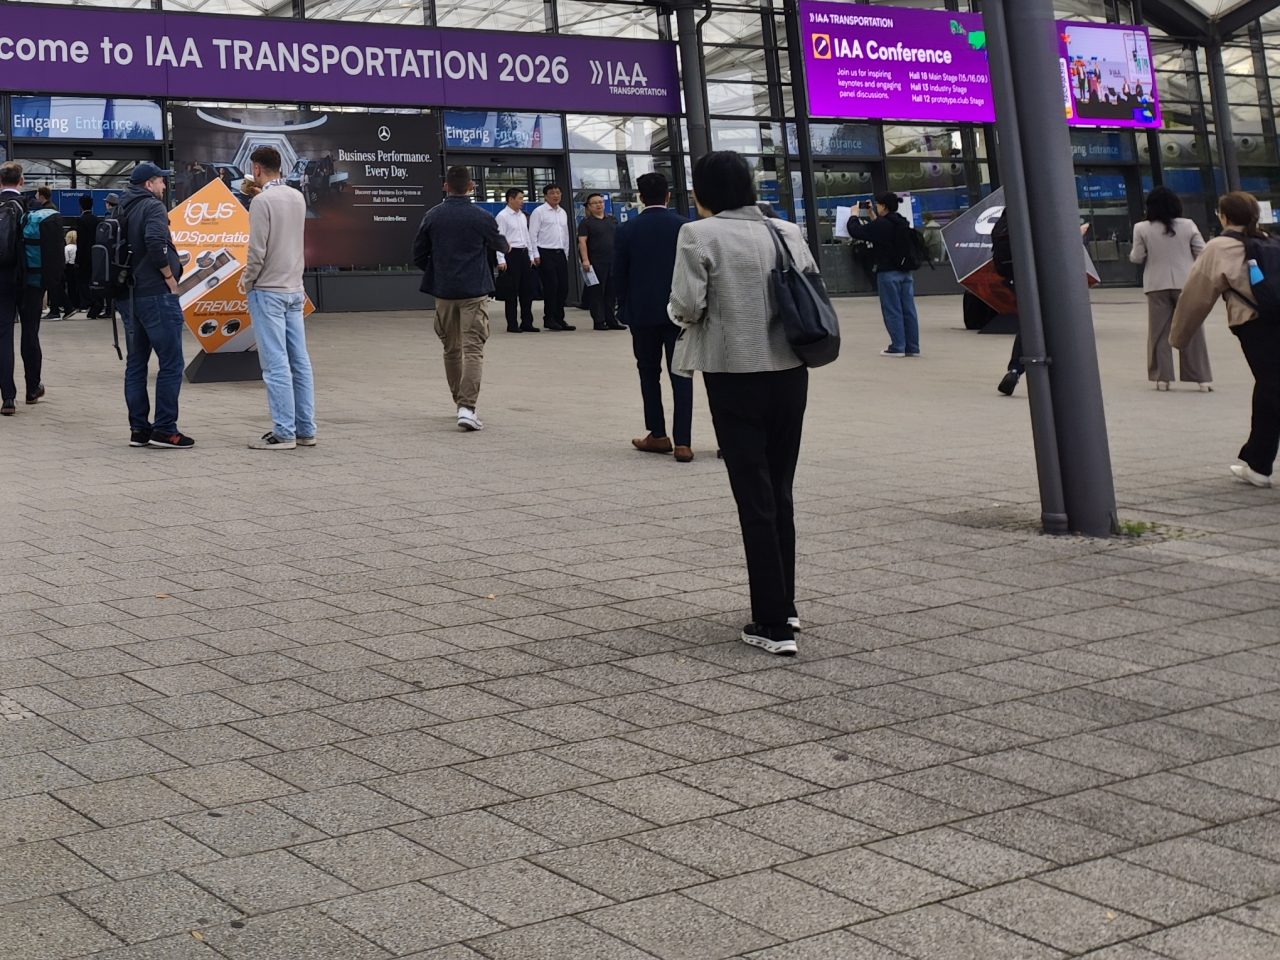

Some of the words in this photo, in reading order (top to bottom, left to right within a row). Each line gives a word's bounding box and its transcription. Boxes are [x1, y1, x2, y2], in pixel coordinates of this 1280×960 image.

[815, 13, 829, 24] IAA
[830, 14, 894, 29] TRANSPORTATION
[833, 37, 864, 59] IAA
[865, 40, 953, 65] Conference
[100, 36, 134, 66] to
[145, 35, 204, 69] IAA
[212, 38, 489, 81] TRANSPORTATION
[497, 53, 570, 85] 2026
[606, 61, 648, 87] IAA
[837, 67, 849, 76] Join
[858, 68, 867, 77] for
[867, 69, 892, 80] inspiring
[908, 71, 920, 80] Hall
[928, 72, 942, 81] Main
[942, 73, 958, 83] Stage
[608, 86, 668, 97] TRANSPORTATION
[837, 79, 863, 88] keynotes
[864, 80, 875, 88] and
[876, 81, 902, 91] engaging
[910, 82, 921, 91] Hall
[930, 84, 951, 94] Industry
[952, 84, 968, 94] Stage
[839, 90, 855, 99] panel
[856, 90, 890, 99] discussions.
[911, 94, 923, 102] Hall
[969, 96, 985, 106] Stage
[13, 114, 69, 133] Eingang
[75, 115, 134, 131] Entrance
[446, 126, 490, 143] Eingang
[494, 126, 540, 141] Entrance
[338, 148, 376, 162] Business
[377, 149, 433, 163] Performance.
[1088, 143, 1119, 154] Entrance
[365, 164, 389, 180] Every
[391, 165, 409, 180] Day.
[184, 200, 237, 226] igus
[170, 230, 250, 246] NDSportatio
[193, 299, 250, 314] TRENDS
